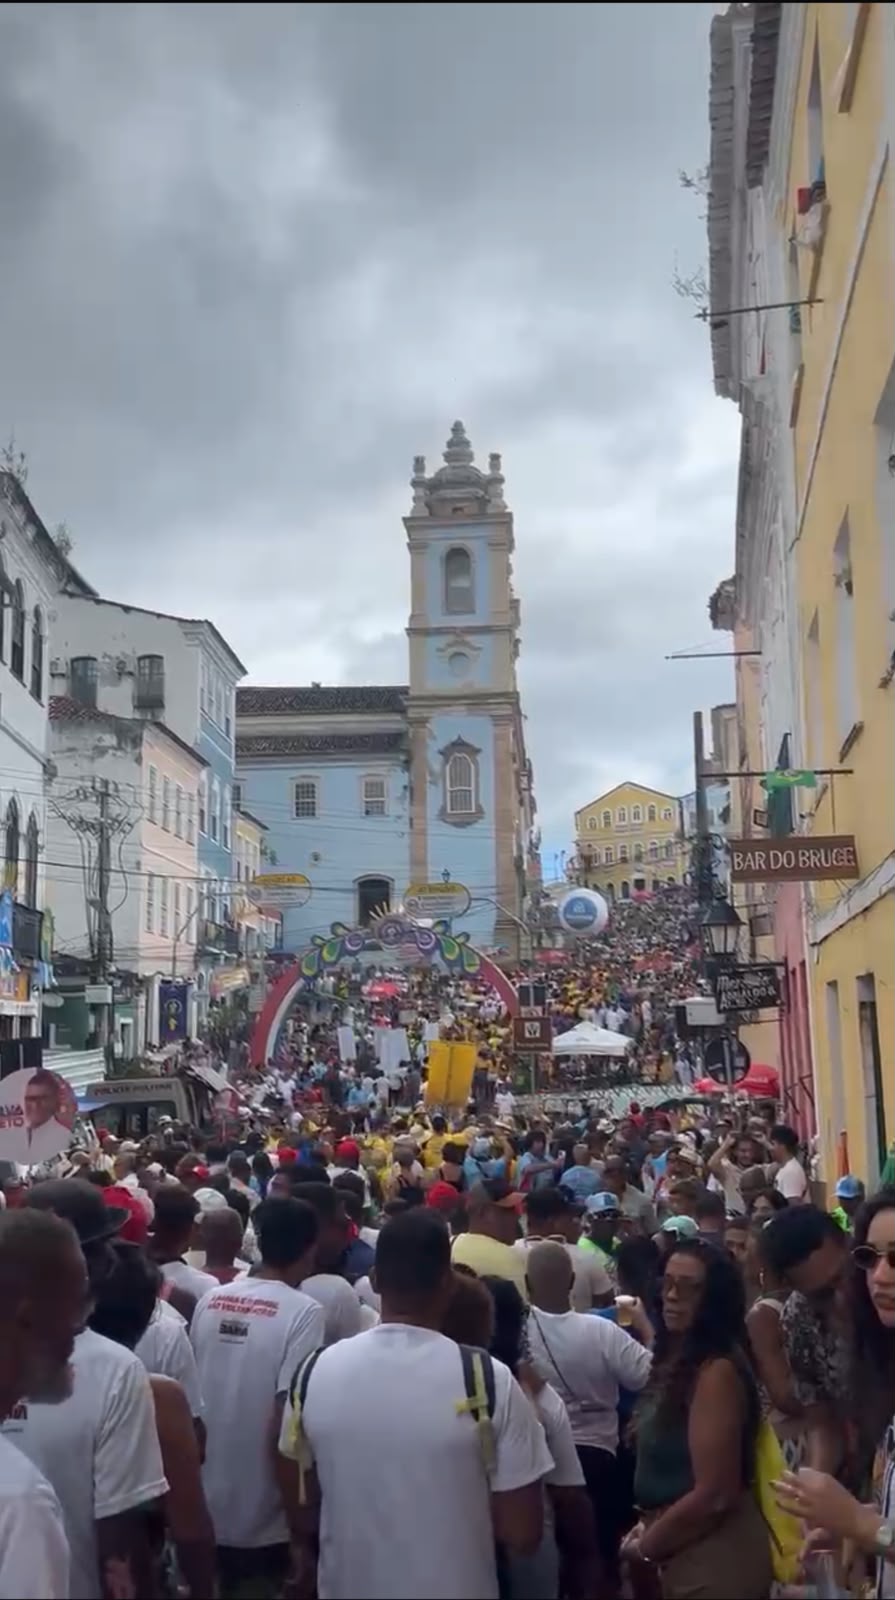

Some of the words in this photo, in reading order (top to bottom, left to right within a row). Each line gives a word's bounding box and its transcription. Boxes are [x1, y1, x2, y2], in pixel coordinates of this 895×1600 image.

[733, 851, 767, 871] BAR
[769, 849, 796, 870] DO
[797, 847, 856, 868] BRUCE
